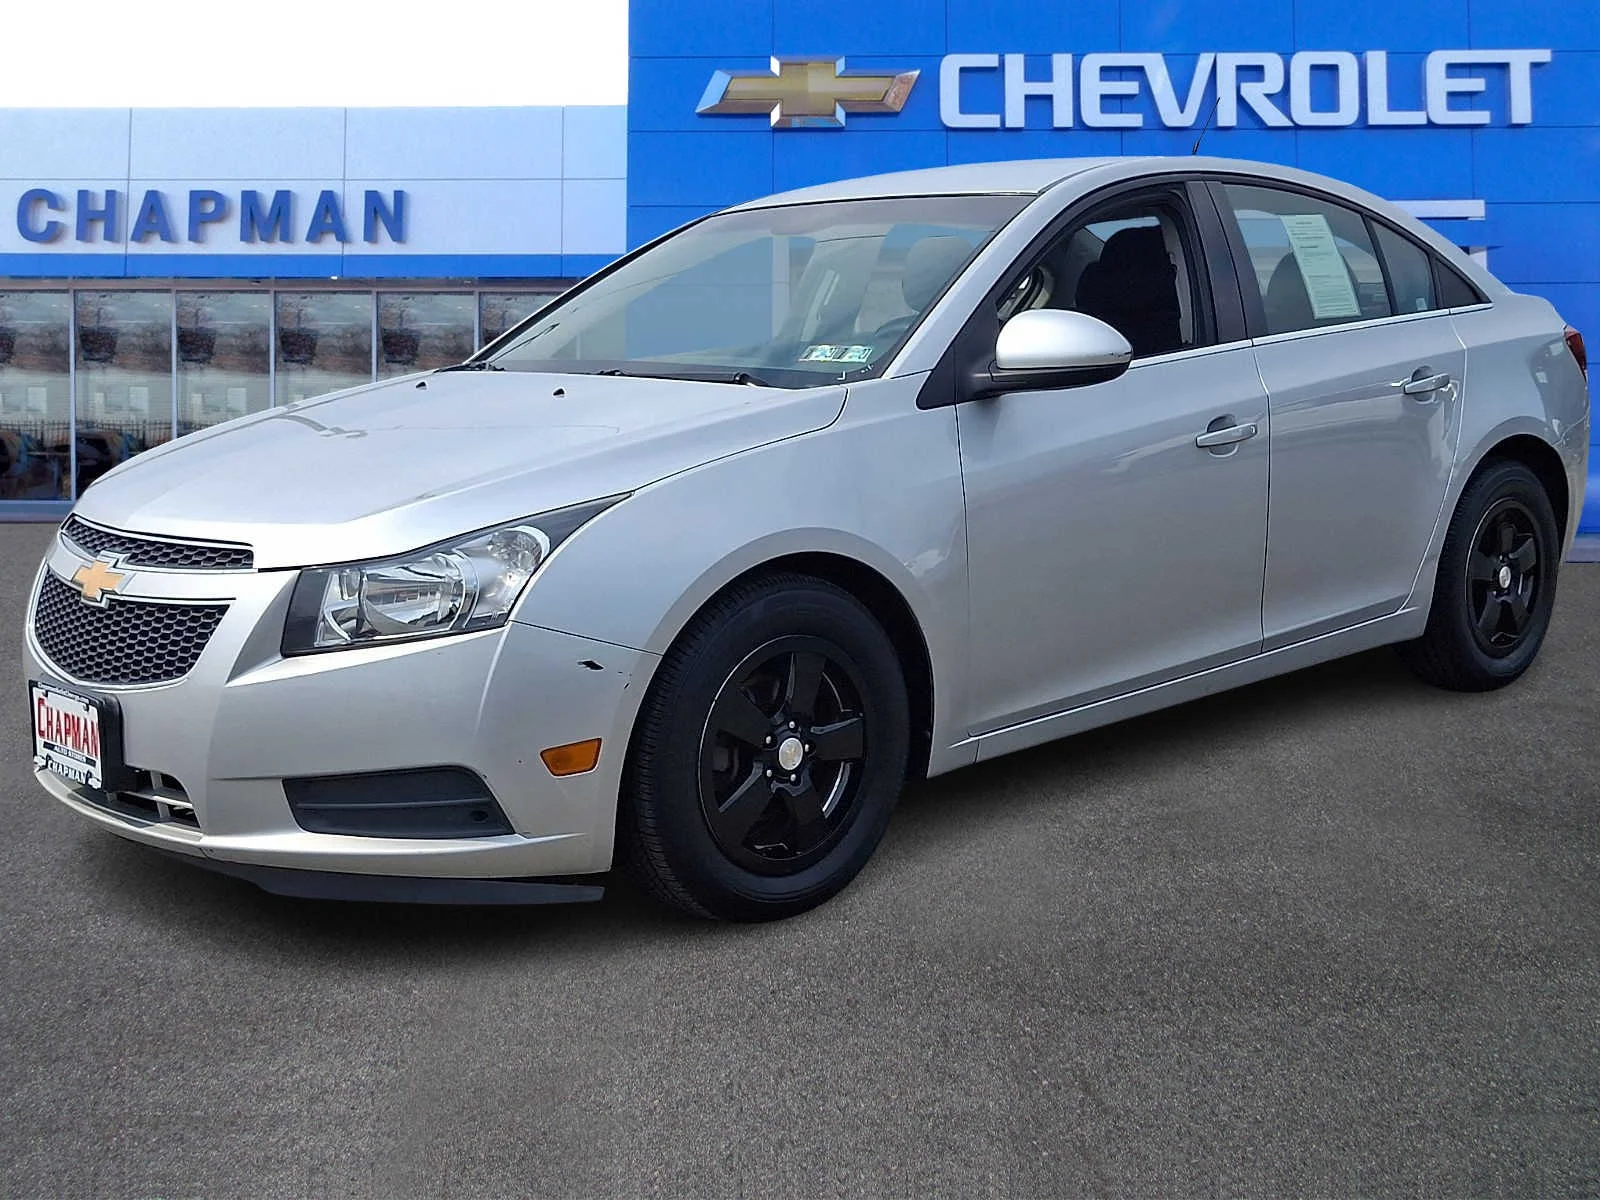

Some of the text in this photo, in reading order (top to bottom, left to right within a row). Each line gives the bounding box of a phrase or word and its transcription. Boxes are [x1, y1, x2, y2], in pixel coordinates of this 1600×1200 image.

[939, 49, 1552, 129] CHEVROLET
[17, 188, 408, 243] CHAPMAN
[37, 698, 98, 758] CHAPMAN
[47, 759, 86, 785] CHAPMAN
